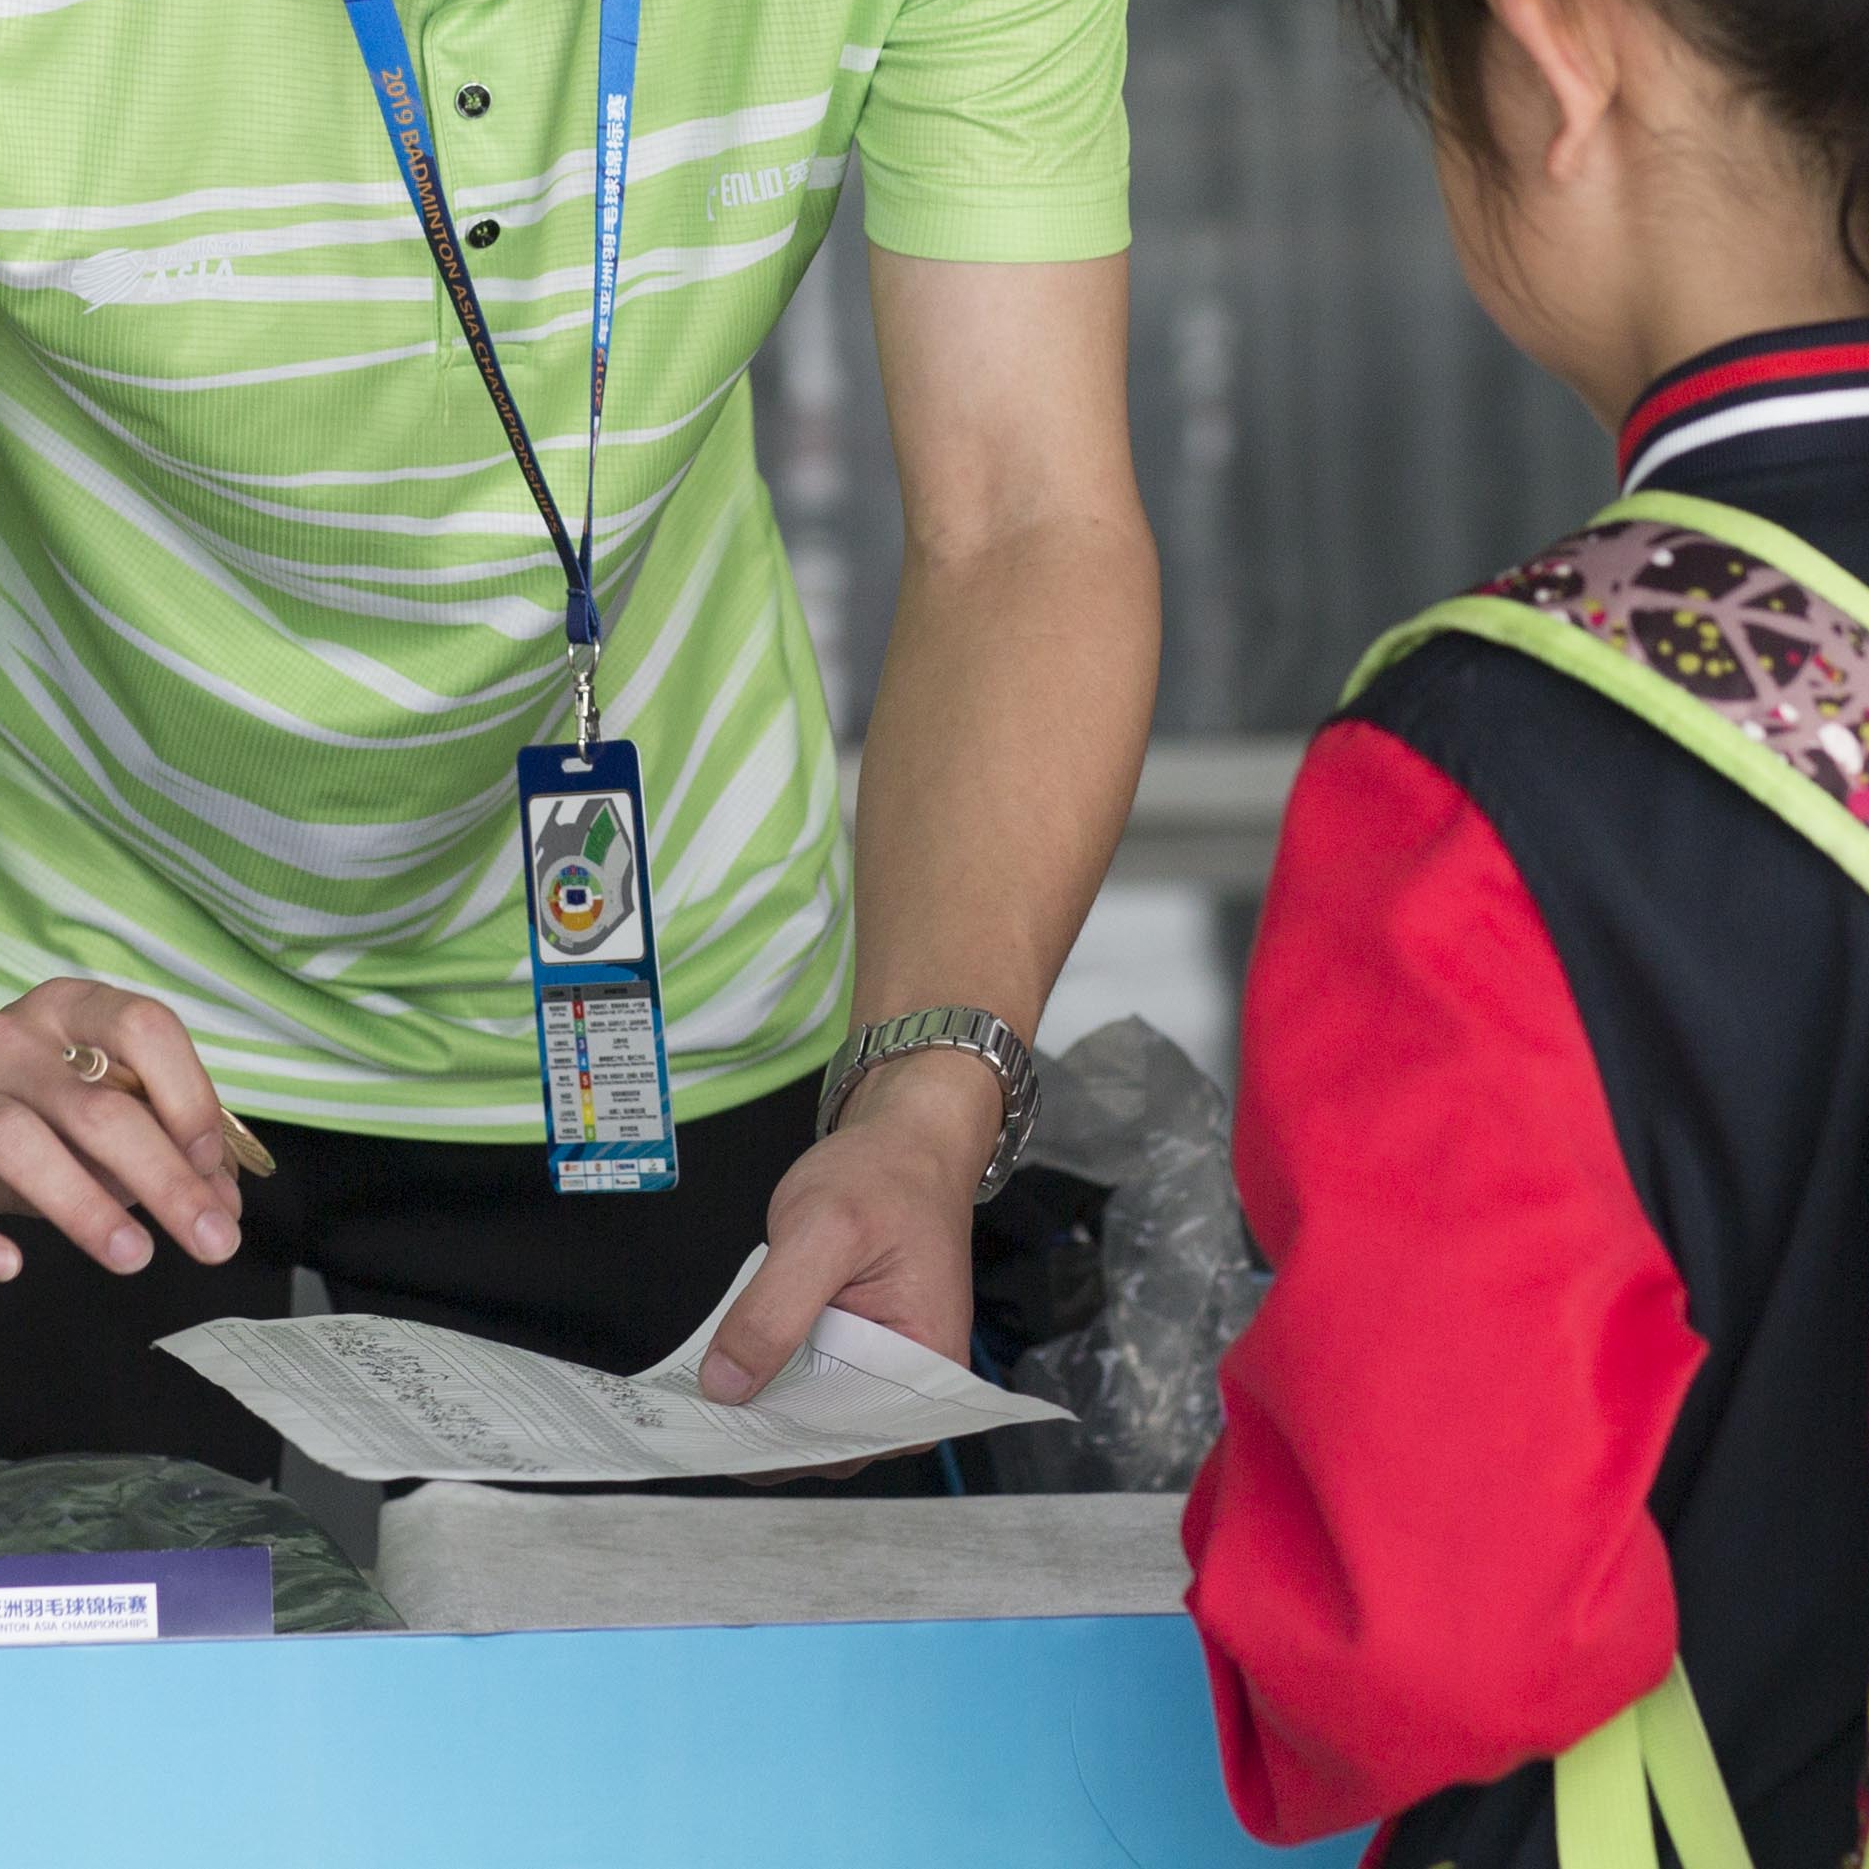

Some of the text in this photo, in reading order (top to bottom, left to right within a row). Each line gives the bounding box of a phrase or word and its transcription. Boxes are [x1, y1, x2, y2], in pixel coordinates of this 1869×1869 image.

[145, 258, 236, 298] ASIA
[380, 67, 560, 534] 2019 BADMINTON ASIA CHAMPIONSHIPS
[34, 1621, 58, 1631] ASIA
[62, 1618, 149, 1630] CHAMPIONSHIPS
